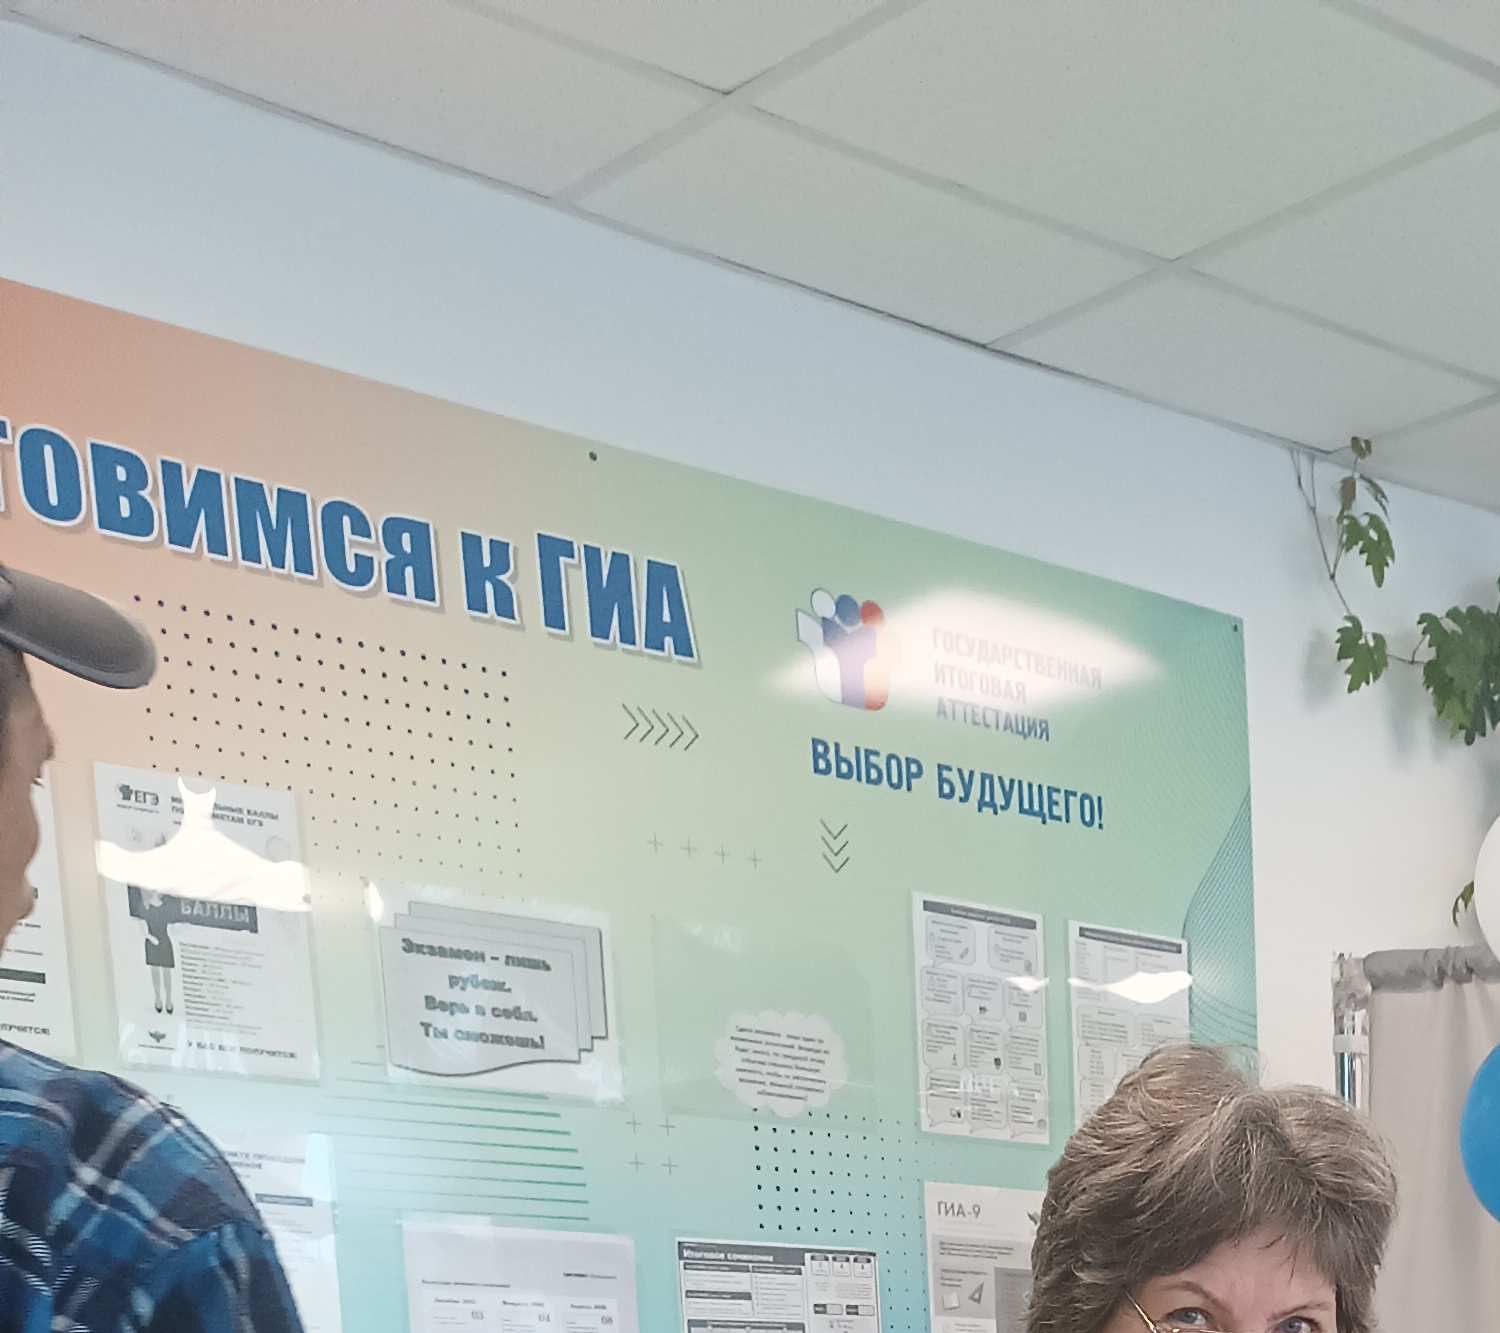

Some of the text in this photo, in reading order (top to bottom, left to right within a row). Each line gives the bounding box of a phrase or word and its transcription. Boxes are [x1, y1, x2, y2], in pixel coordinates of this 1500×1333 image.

[537, 533, 696, 660] ГИА
[933, 628, 1102, 689] ГОСУДАРСТВЕННАЯ
[934, 662, 1026, 704] ИТОГОВАЯ
[936, 697, 1050, 742] АТТЕСТАЦИЯ
[134, 790, 160, 806] ЕГЭ
[811, 738, 1104, 830] ВЫБОР БУДУЩЕГО!
[402, 937, 486, 963] Экзамен
[424, 994, 469, 1017] Верь
[420, 1021, 545, 1050] Ты сможешь!
[937, 1200, 981, 1219] ГИА-9
